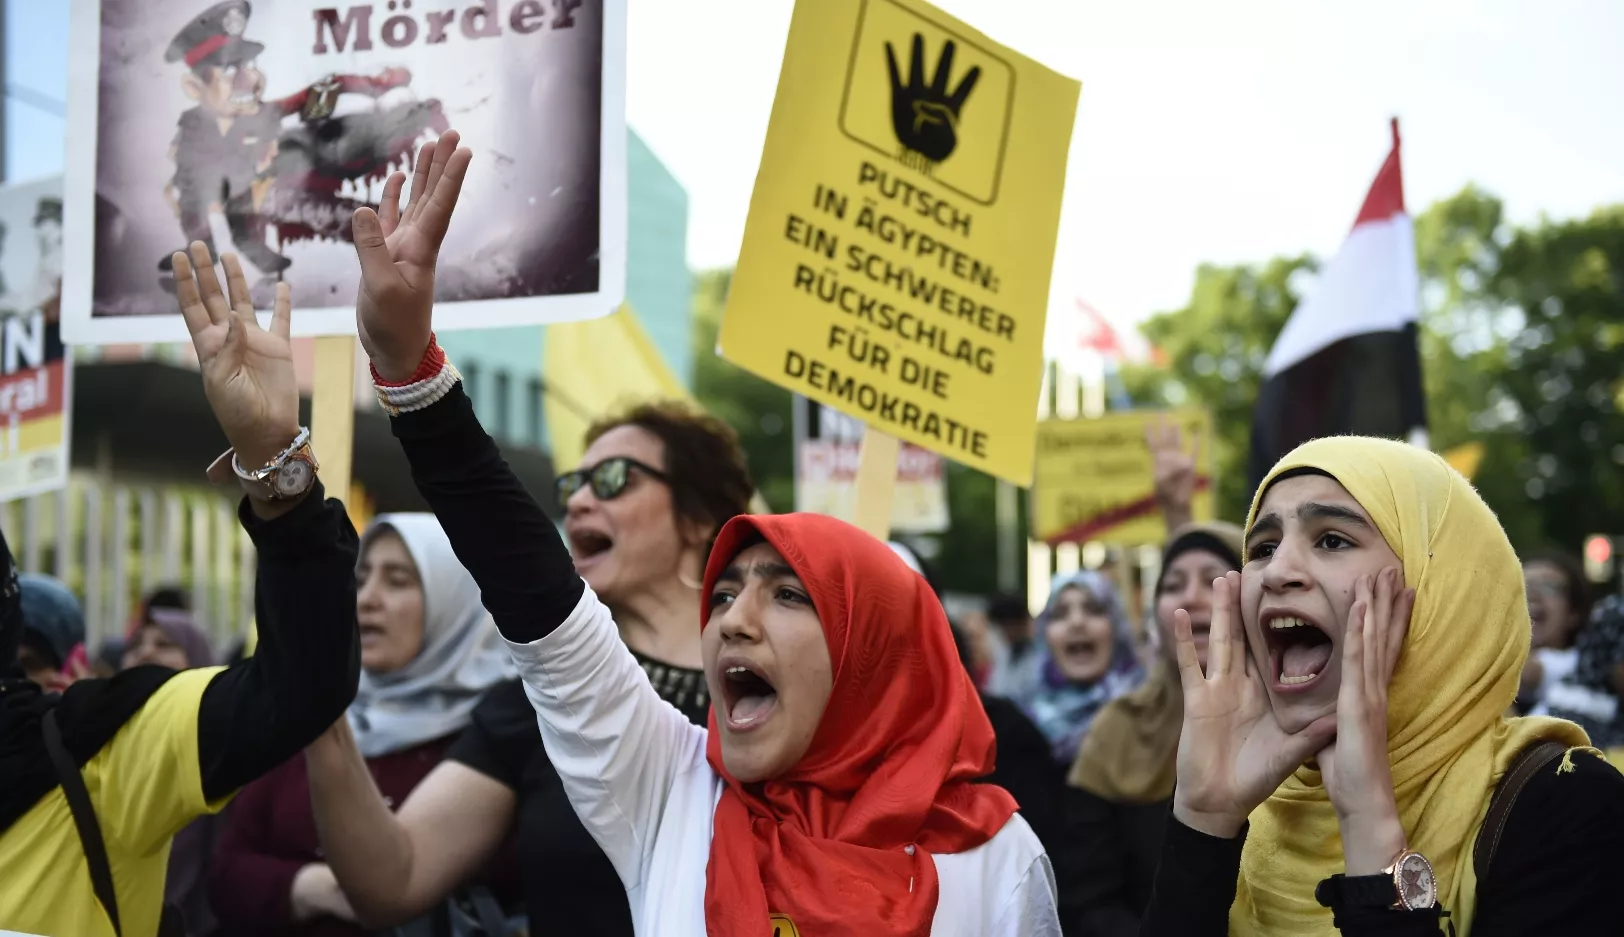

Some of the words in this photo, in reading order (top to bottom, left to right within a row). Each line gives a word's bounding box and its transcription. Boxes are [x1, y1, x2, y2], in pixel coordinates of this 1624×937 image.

[312, 0, 581, 55] Mörder
[813, 184, 846, 220] IN
[855, 197, 1001, 293] ÄGYPTEN:
[858, 162, 972, 238] PUTSCH
[785, 214, 840, 259] EIN
[847, 246, 1016, 341] SCHWERER
[794, 265, 995, 375] RÜCKSCHLAG
[0, 313, 44, 374] N
[828, 325, 890, 374] FÜR
[899, 361, 950, 400] DIE
[785, 350, 989, 459] DEMOKRATIE
